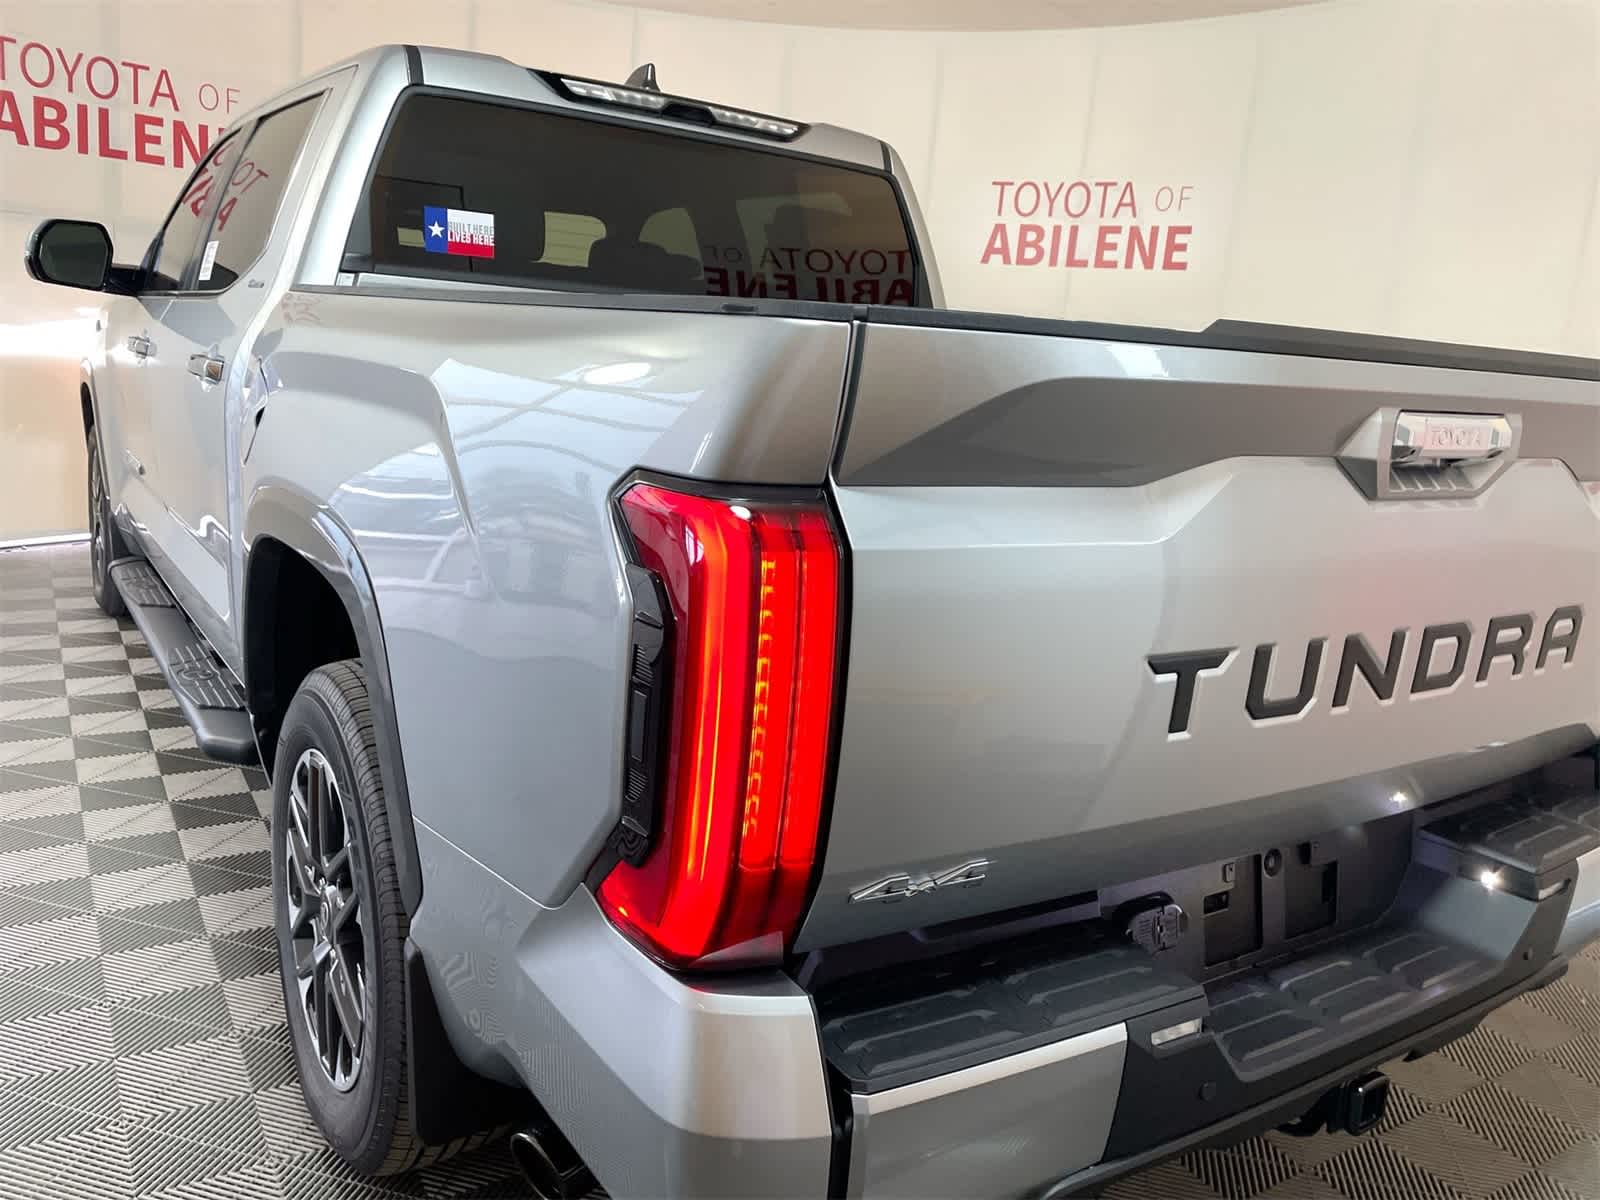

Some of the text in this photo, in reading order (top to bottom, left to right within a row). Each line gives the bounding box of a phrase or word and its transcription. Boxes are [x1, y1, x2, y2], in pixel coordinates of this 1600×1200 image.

[198, 83, 241, 113] OF
[0, 89, 232, 169] ABILEN
[991, 181, 1194, 218] TOYOTA OF
[448, 231, 495, 247] LIVES HERE
[980, 223, 1192, 271] ABILENE
[1146, 605, 1584, 740] TUNDRA
